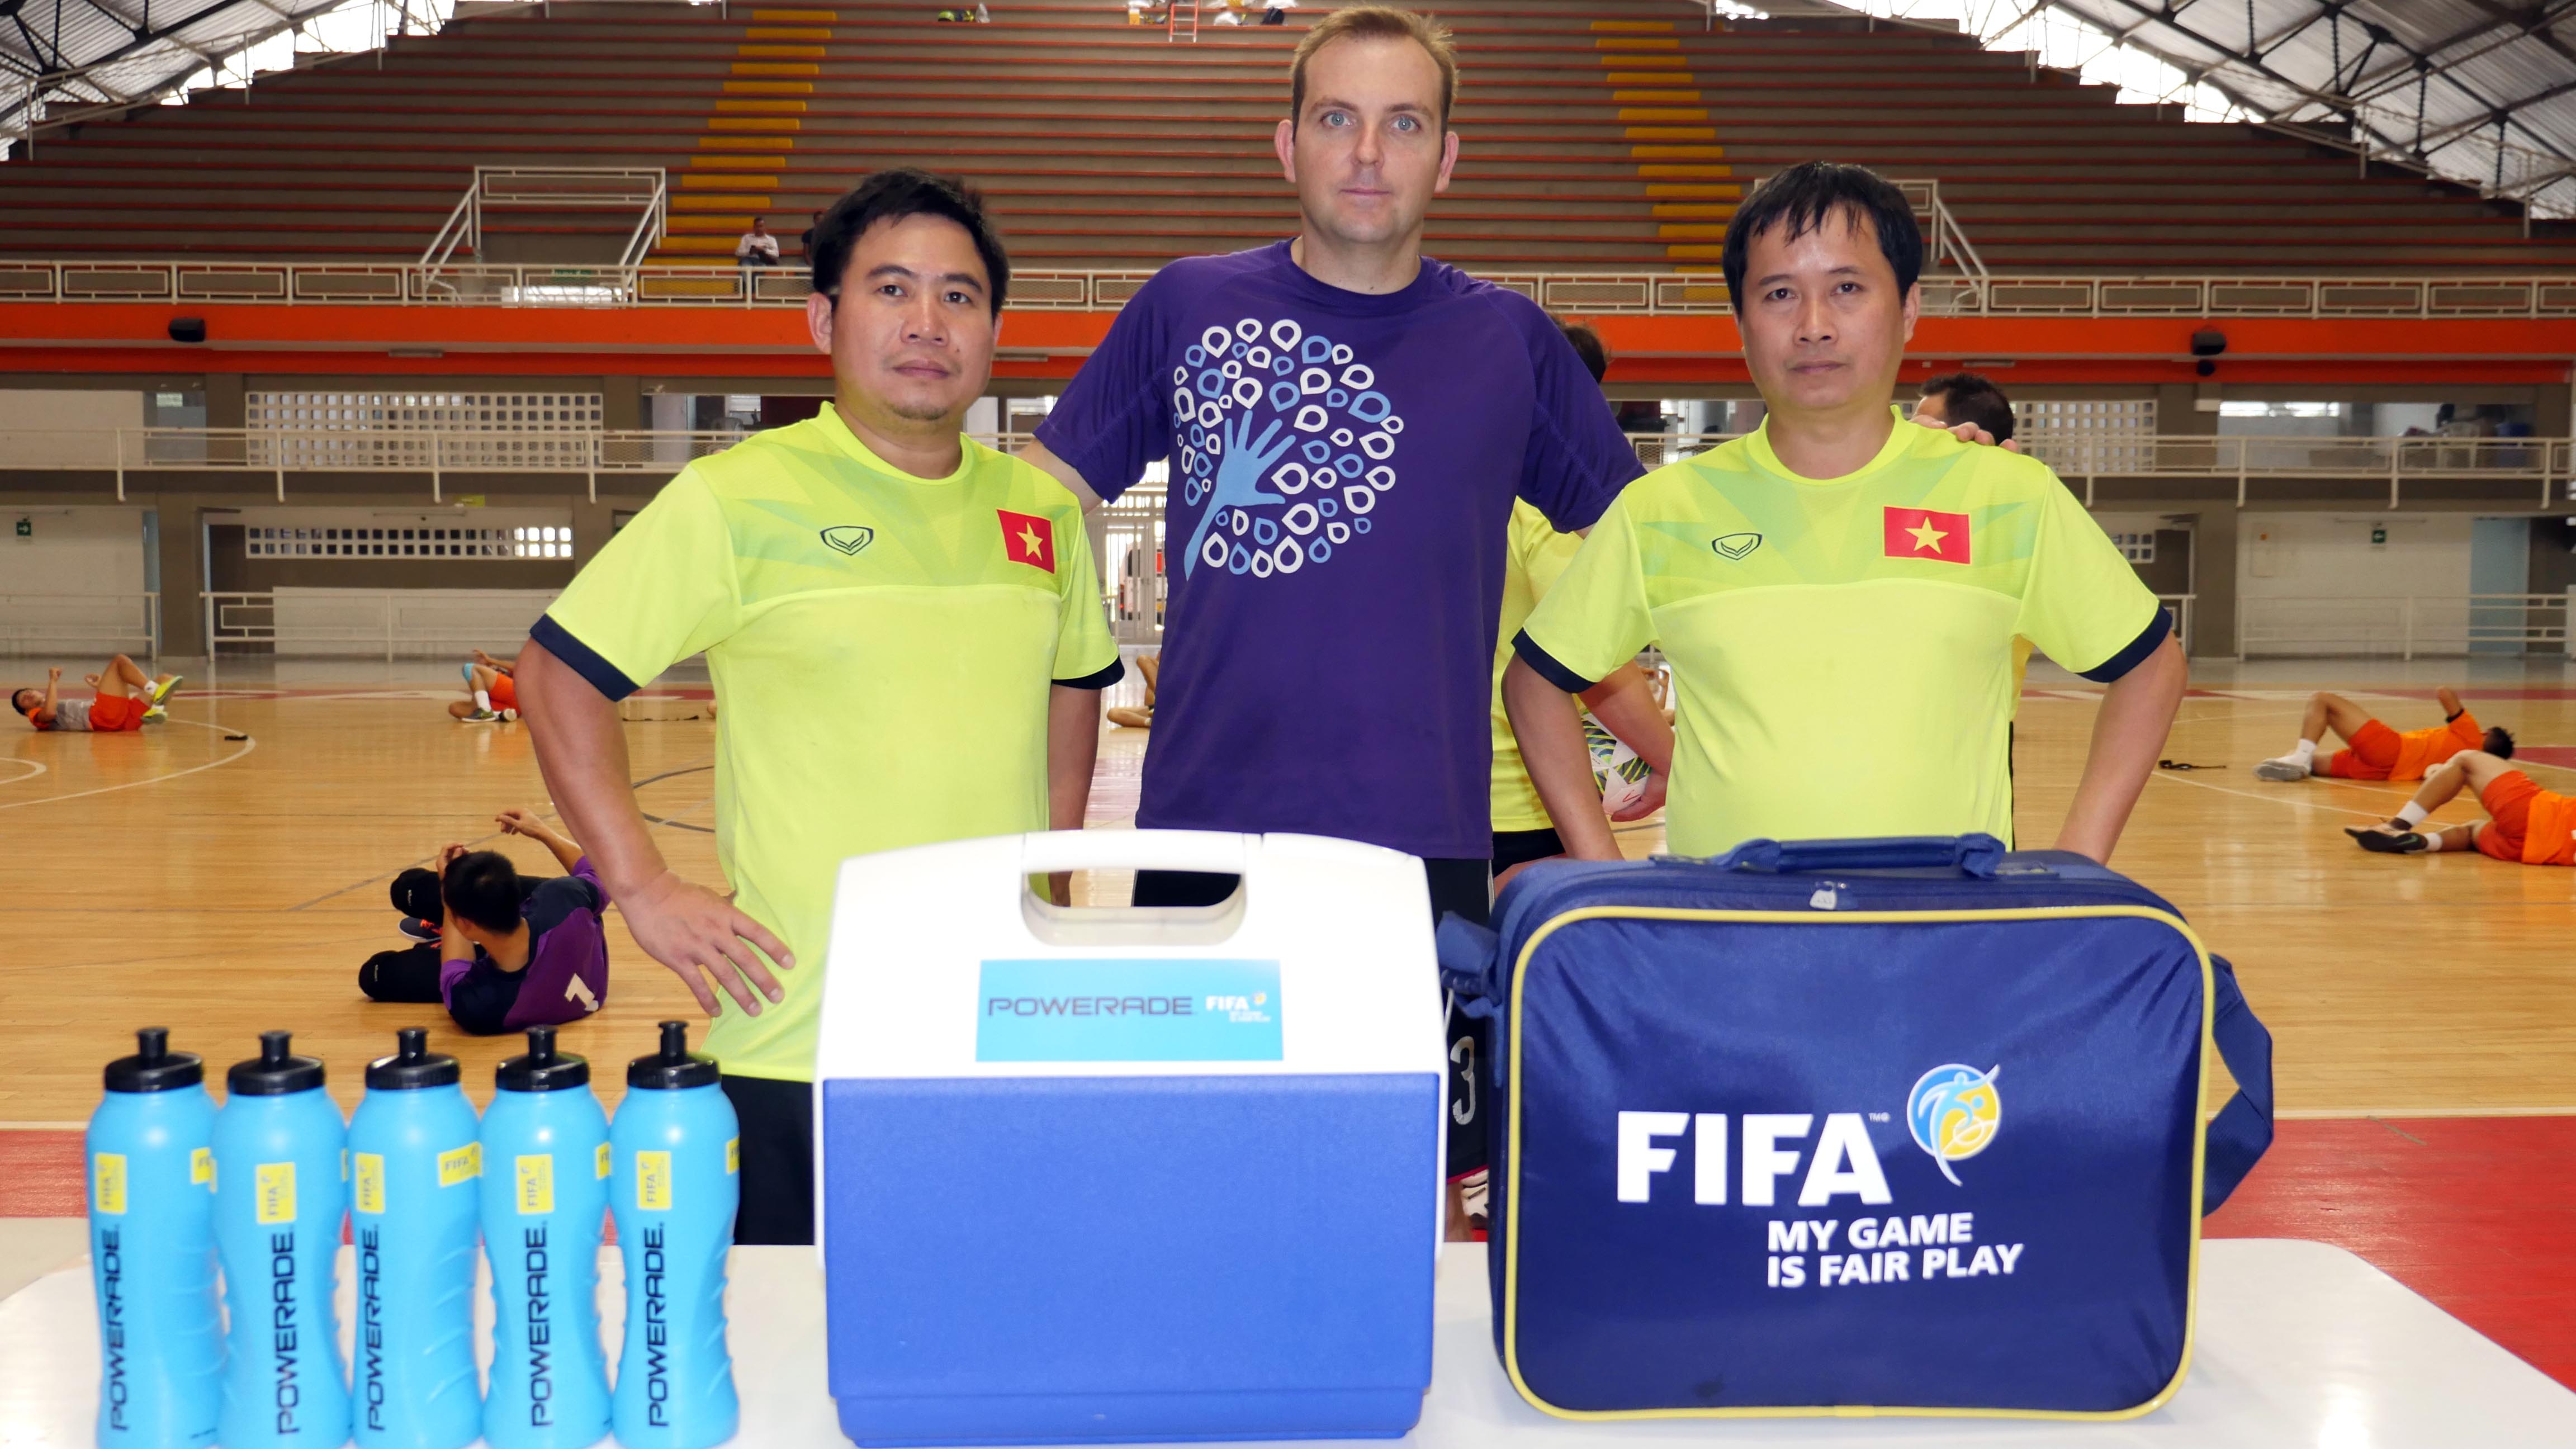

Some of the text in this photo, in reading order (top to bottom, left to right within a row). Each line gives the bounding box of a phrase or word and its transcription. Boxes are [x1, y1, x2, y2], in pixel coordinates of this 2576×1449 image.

[988, 997, 1194, 1016] POWERADE
[1205, 995, 1250, 1011] FIFA
[1450, 1036, 1476, 1125] 3
[444, 1156, 470, 1171] FIFA
[646, 1173, 657, 1203] FIFA
[1617, 1111, 1892, 1206] FIFA
[527, 1177, 538, 1207] FIFA
[1768, 1212, 1973, 1252] MY GAME
[1768, 1243, 2024, 1287] IS FAIR PLAY
[101, 1229, 128, 1431] POWERADE
[272, 1232, 300, 1434] POWERADE
[362, 1229, 385, 1431] POWERADE
[525, 1228, 553, 1428] POWERADE
[644, 1228, 669, 1427] POWERADE
